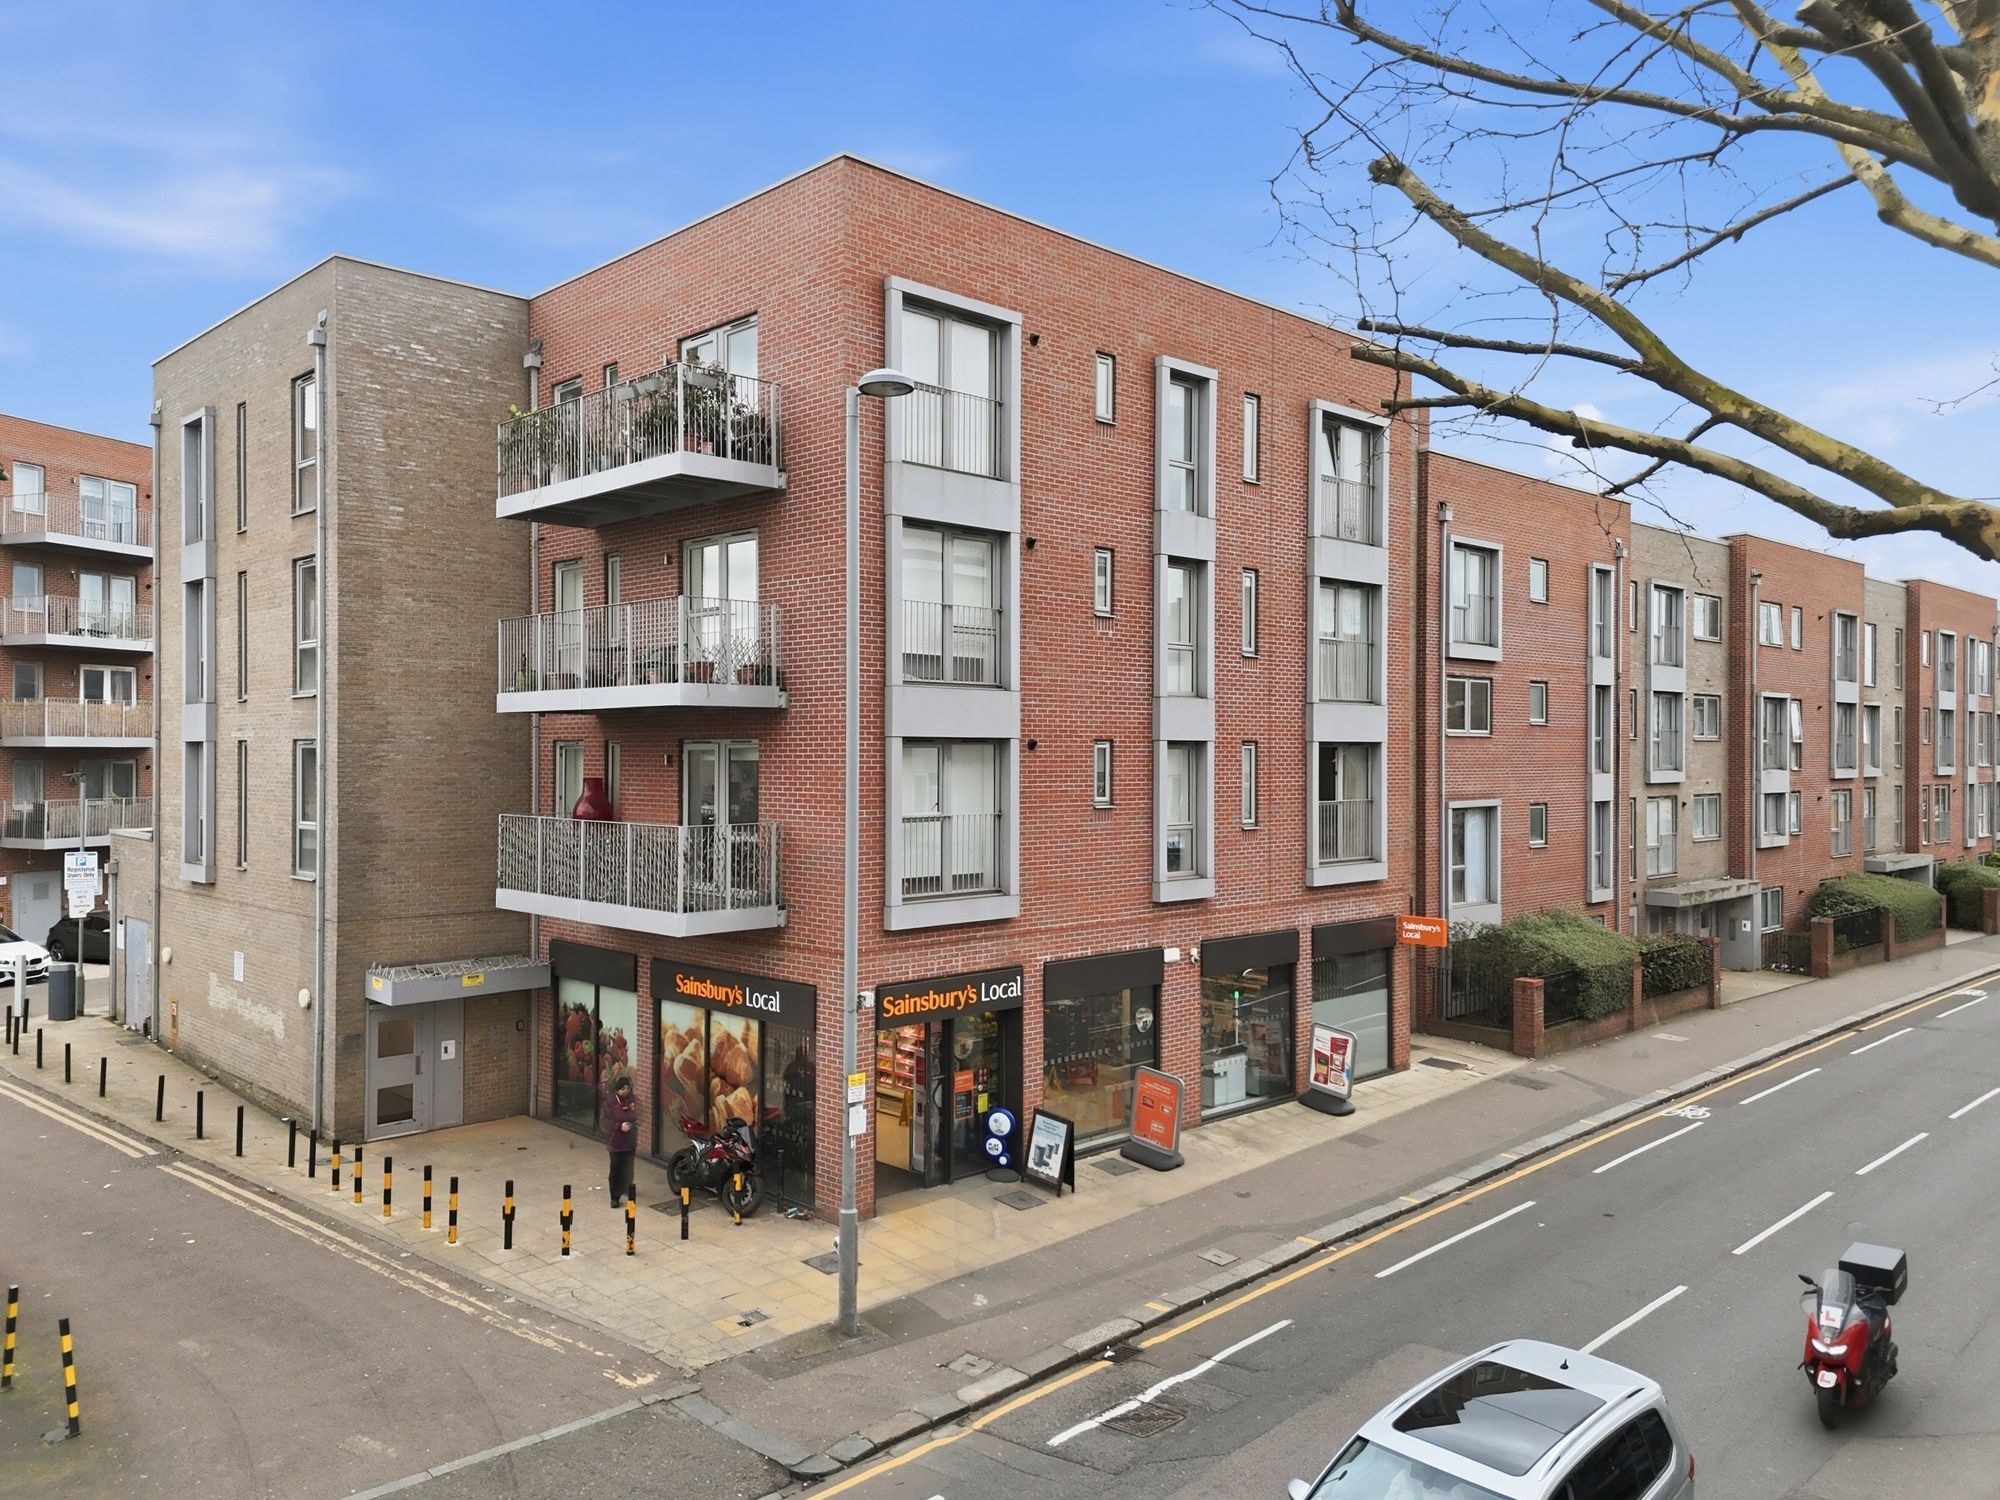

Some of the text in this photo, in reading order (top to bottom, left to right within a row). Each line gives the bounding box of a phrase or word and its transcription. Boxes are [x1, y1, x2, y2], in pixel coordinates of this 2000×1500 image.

[1402, 921, 1441, 934] Sainsbury's
[1402, 930, 1421, 939] Local
[675, 974, 780, 1013] Sainsbury's Local
[882, 975, 1021, 1018] Sainsbury's Local
[1825, 1310, 1836, 1323] L
[1820, 1372, 1831, 1384] L
